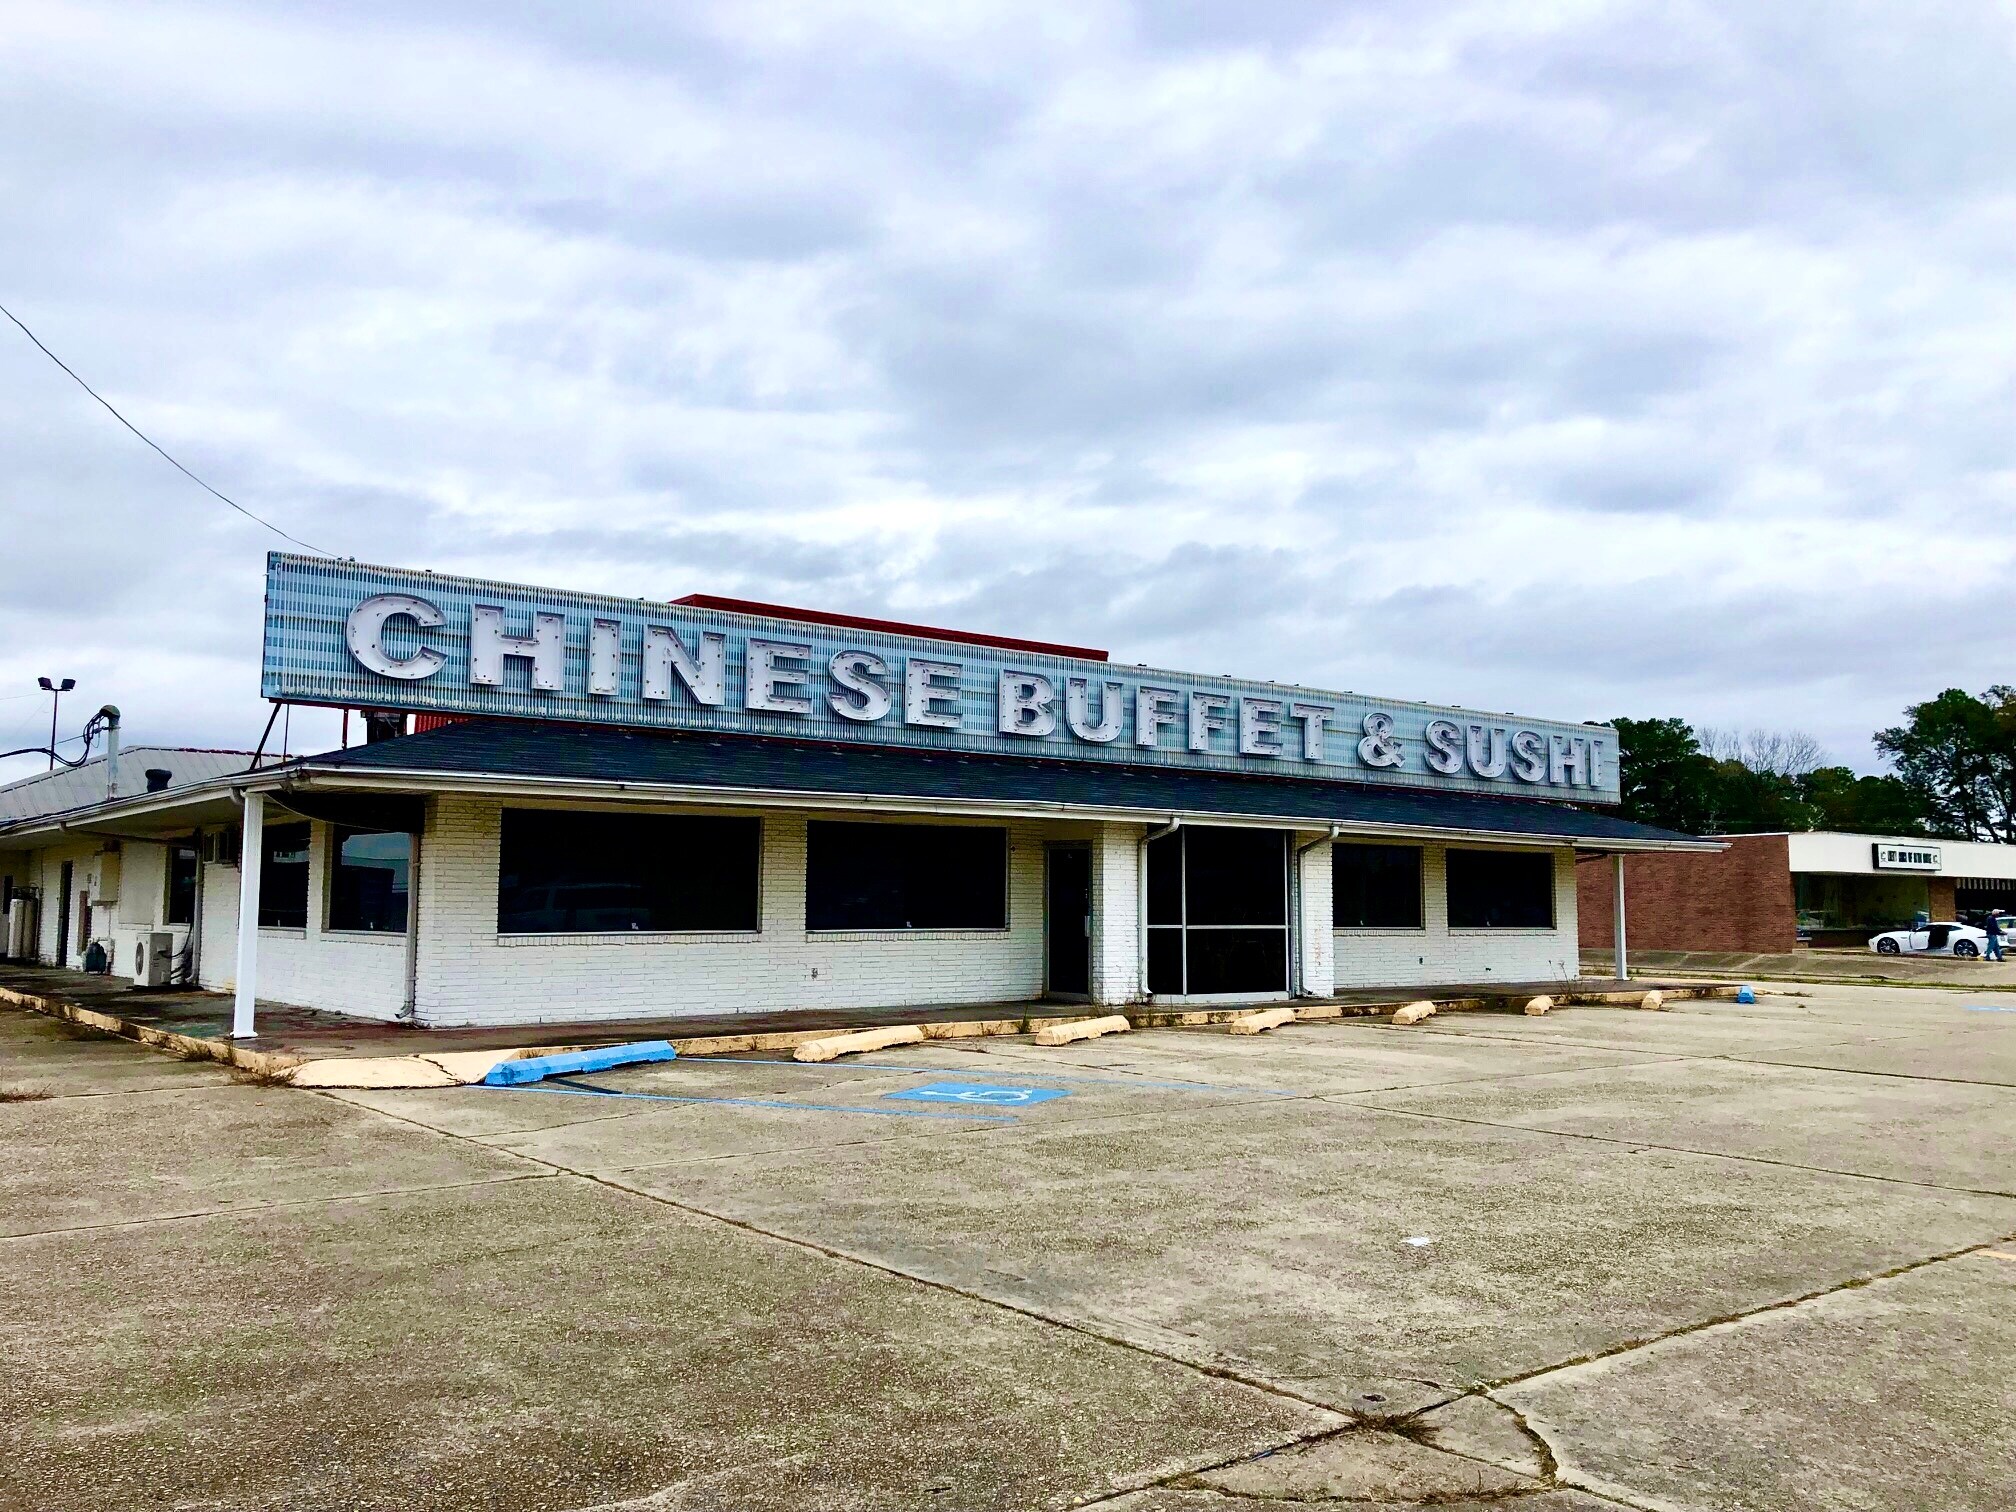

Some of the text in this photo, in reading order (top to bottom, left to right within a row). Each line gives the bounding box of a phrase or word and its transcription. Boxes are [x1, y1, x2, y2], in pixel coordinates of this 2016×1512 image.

[346, 592, 1604, 787] CHINESE BUFFET & SUSHI
